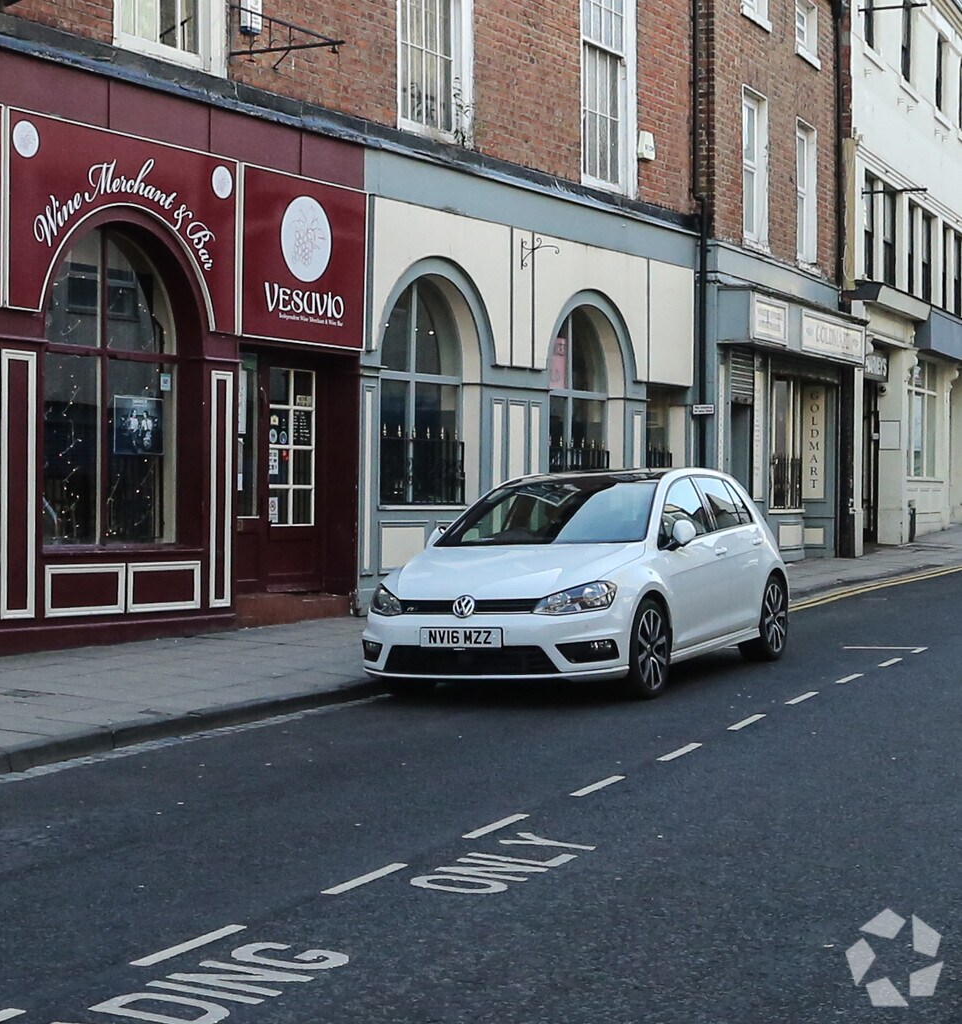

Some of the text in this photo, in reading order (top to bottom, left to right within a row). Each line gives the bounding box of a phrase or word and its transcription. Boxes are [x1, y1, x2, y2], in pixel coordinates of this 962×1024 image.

[33, 158, 216, 271] Wine Merchant & Bar
[264, 281, 344, 319] VESUVIO
[808, 392, 820, 489] GOLDMART
[428, 629, 493, 644] NV16 MZZ
[409, 832, 597, 894] ONLY
[48, 942, 349, 1024] DING
